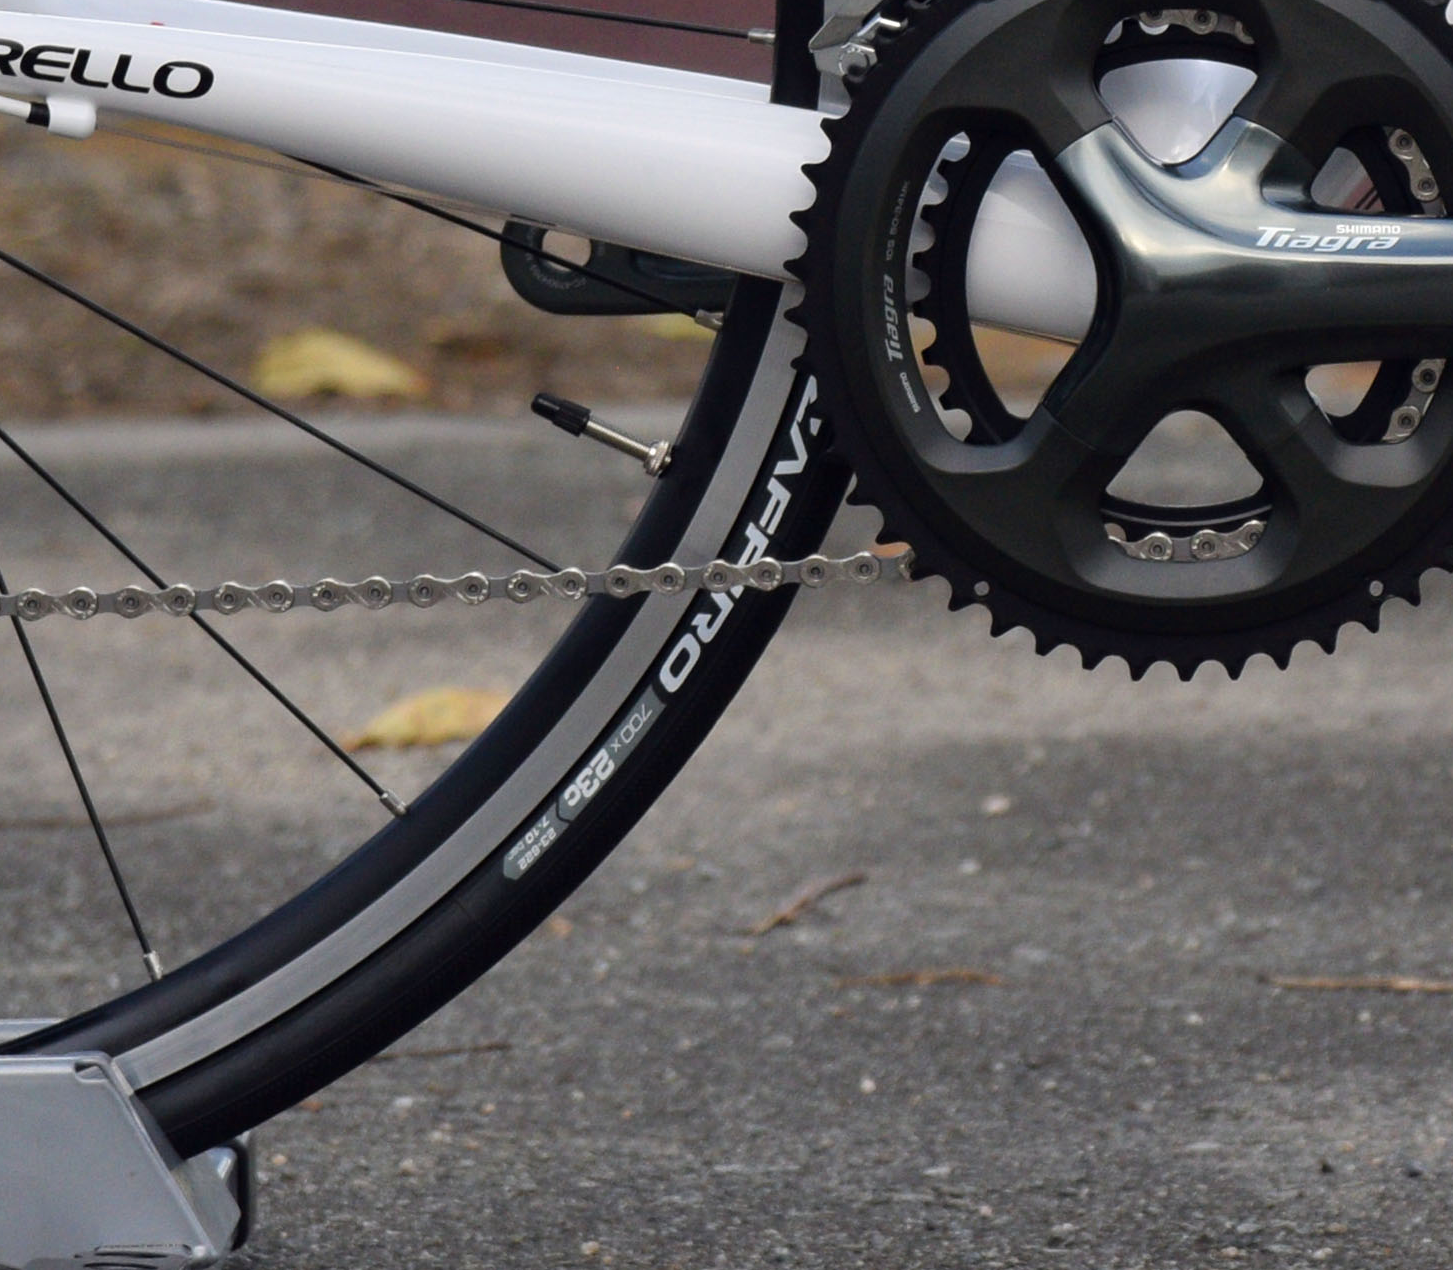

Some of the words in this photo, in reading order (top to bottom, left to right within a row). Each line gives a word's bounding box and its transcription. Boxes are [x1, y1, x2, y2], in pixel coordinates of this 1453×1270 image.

[1255, 225, 1402, 253] Tiagra
[1335, 223, 1402, 235] SHIMANO
[883, 273, 904, 362] Tiagra
[620, 703, 653, 744] 700
